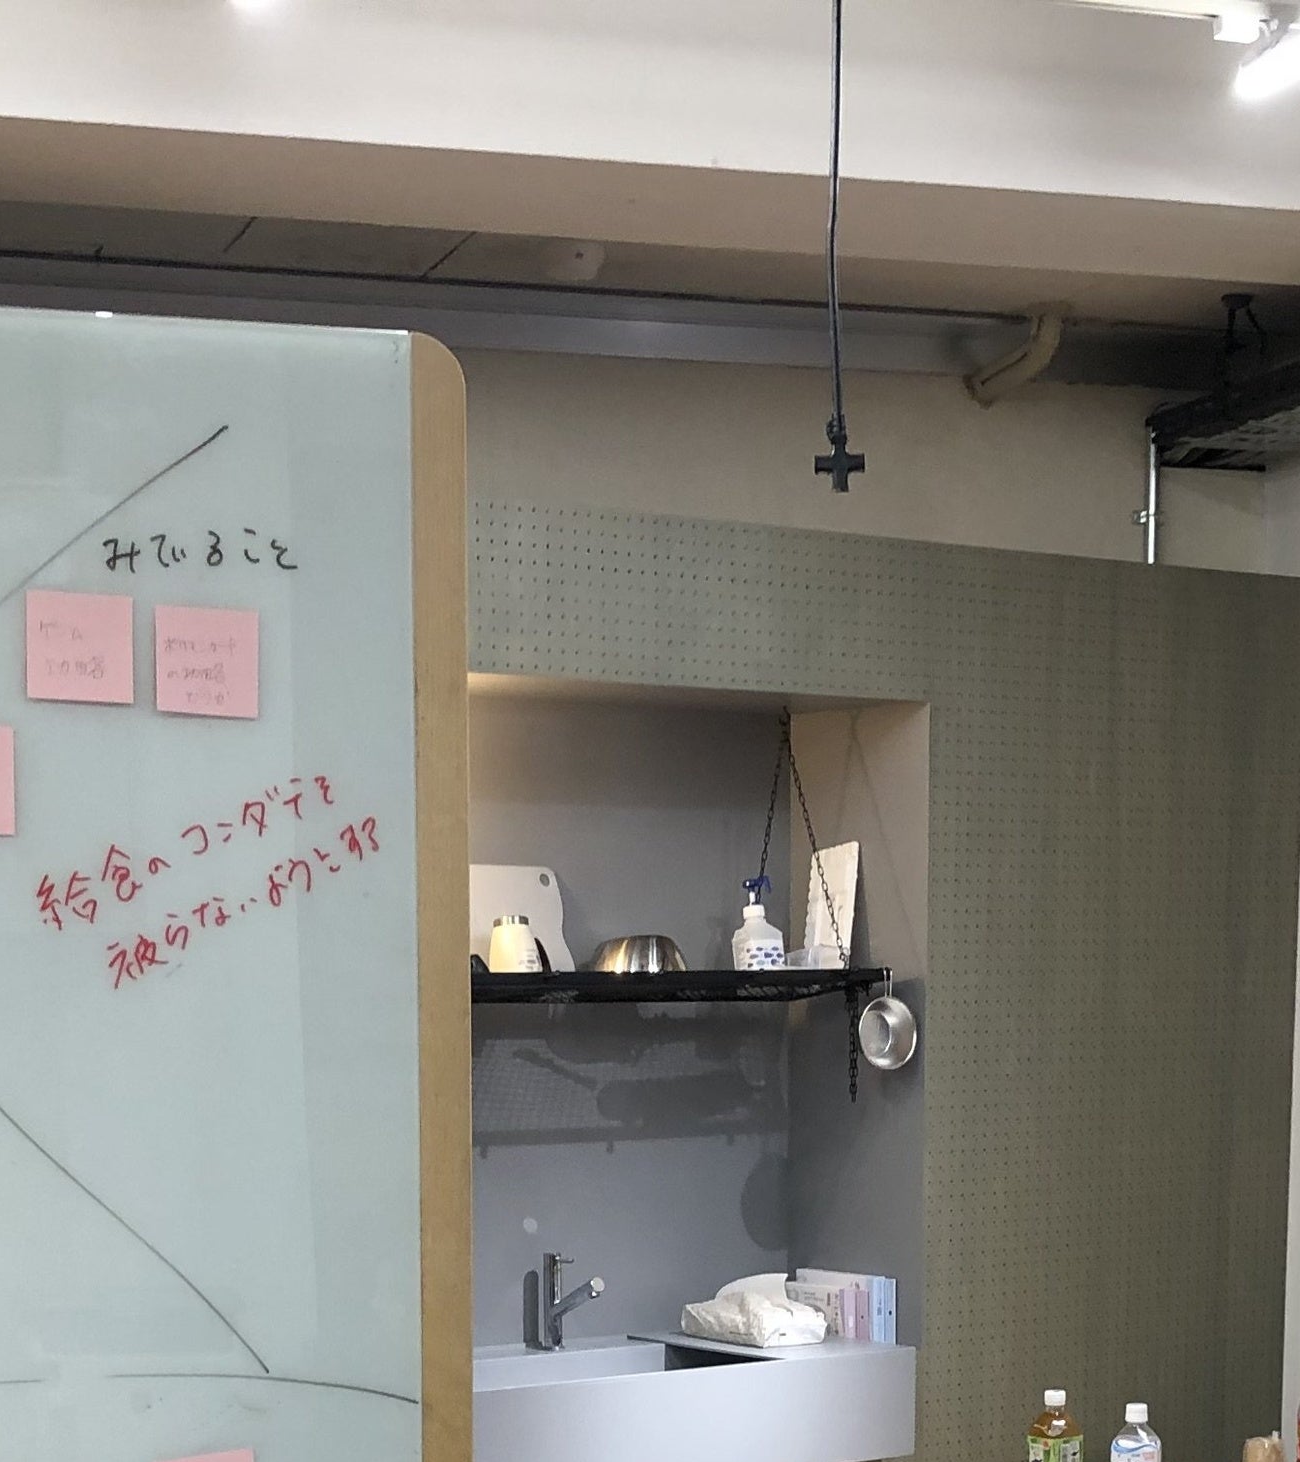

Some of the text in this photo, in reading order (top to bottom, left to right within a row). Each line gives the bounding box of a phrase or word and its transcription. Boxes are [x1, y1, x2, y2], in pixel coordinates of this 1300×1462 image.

[102, 527, 299, 573] みていること
